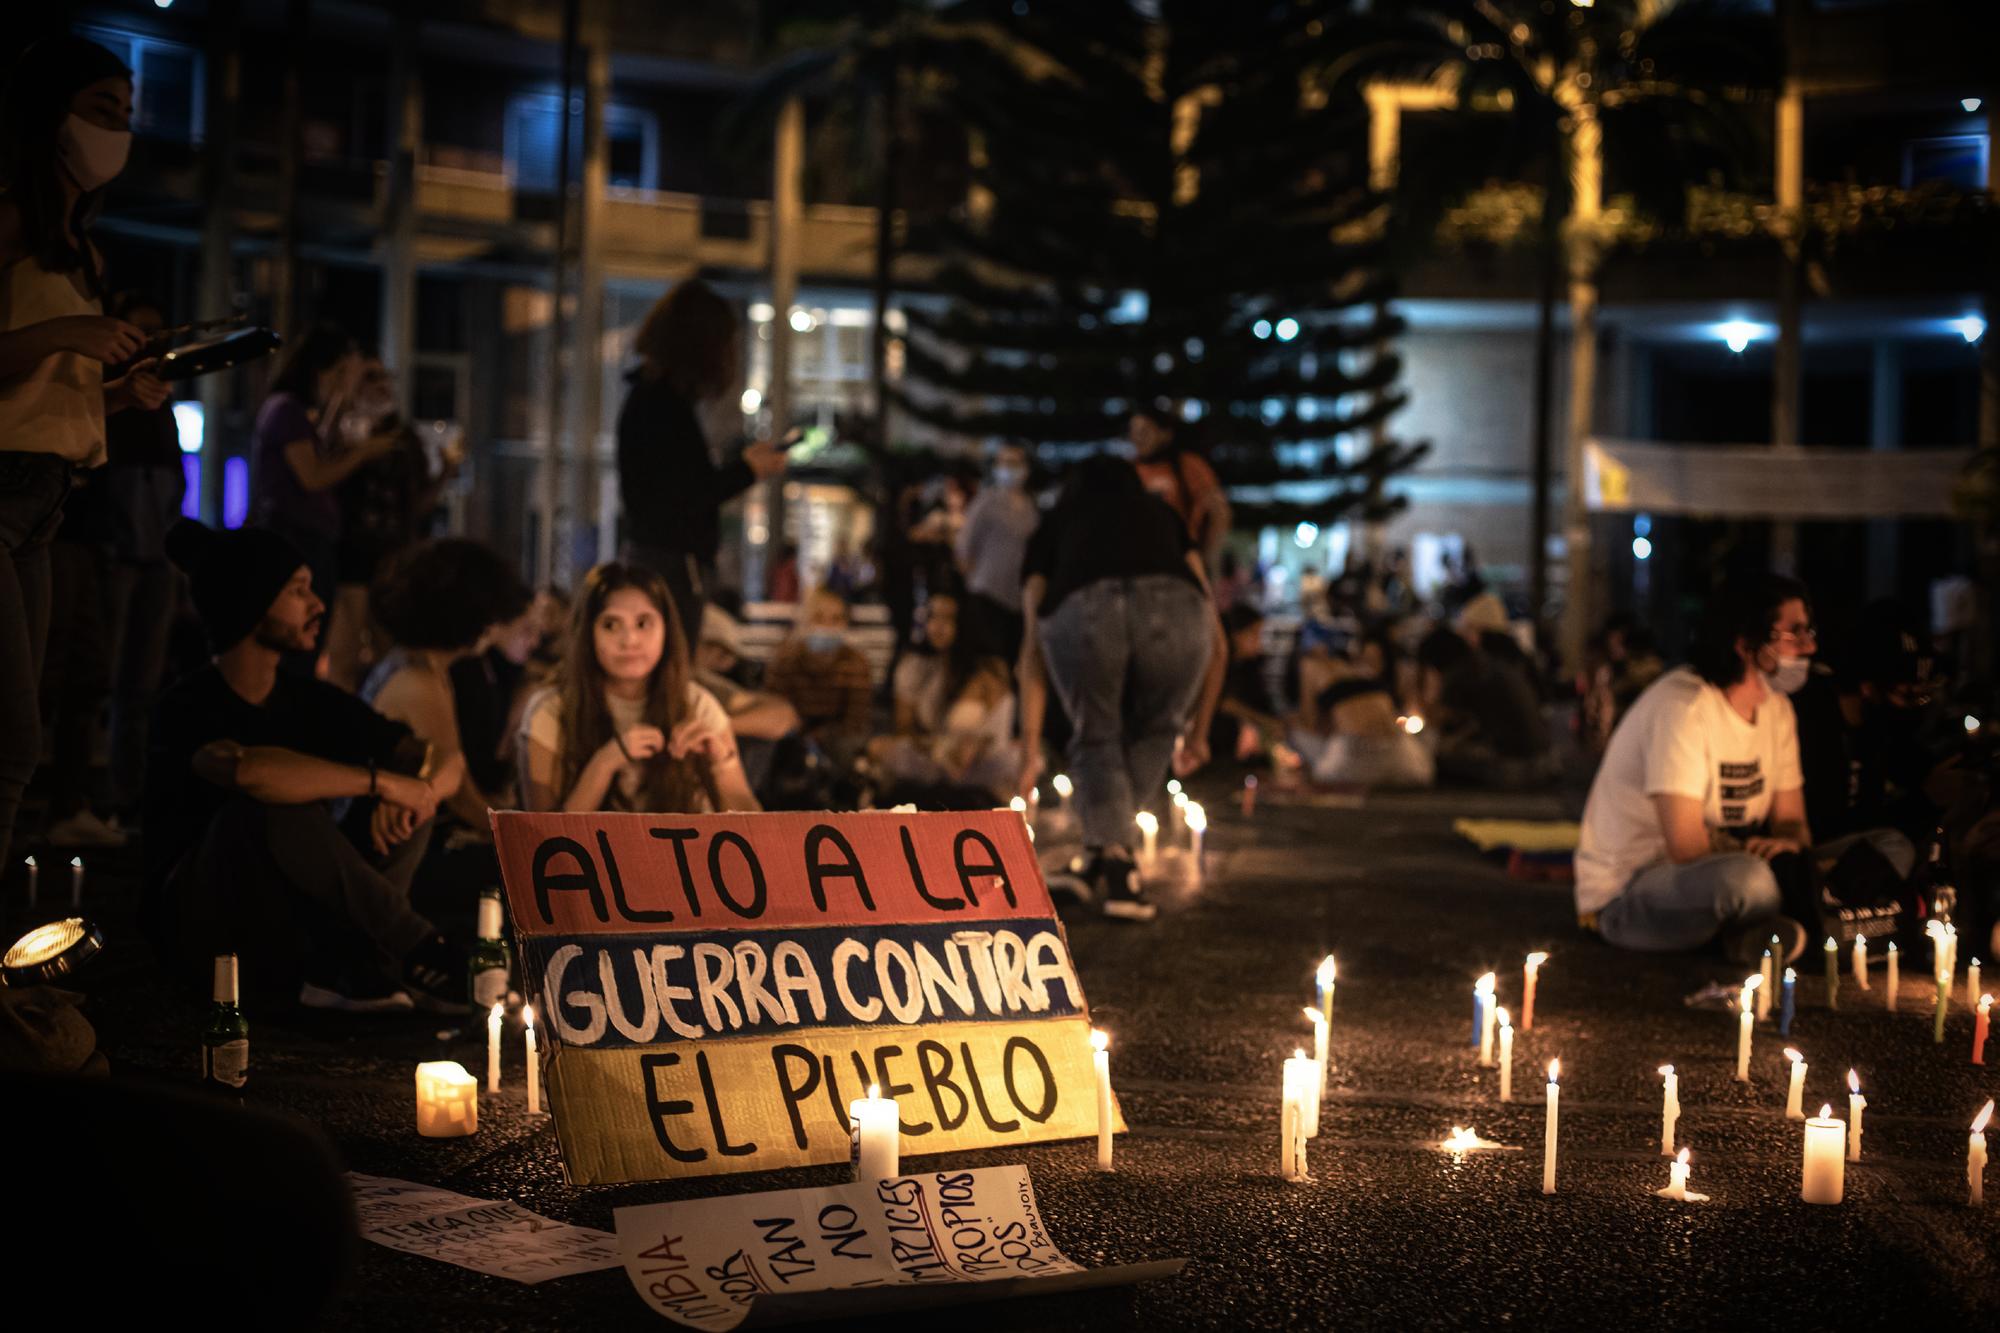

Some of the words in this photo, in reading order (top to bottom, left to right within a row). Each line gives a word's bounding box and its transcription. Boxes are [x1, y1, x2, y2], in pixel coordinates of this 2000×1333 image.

[532, 826, 766, 924] ALTO
[804, 824, 876, 912] A
[900, 824, 1016, 911] LA
[543, 940, 826, 1046] GUERRA
[833, 931, 1083, 1024] CONTRA
[641, 1050, 757, 1163] EL
[772, 1036, 1058, 1152] PUEBLO
[368, 1215, 476, 1240] TENGA
[467, 1205, 530, 1223] QUE
[753, 1218, 816, 1284] TAN
[818, 1204, 873, 1259] NO
[936, 1173, 1007, 1275] PROPIOS
